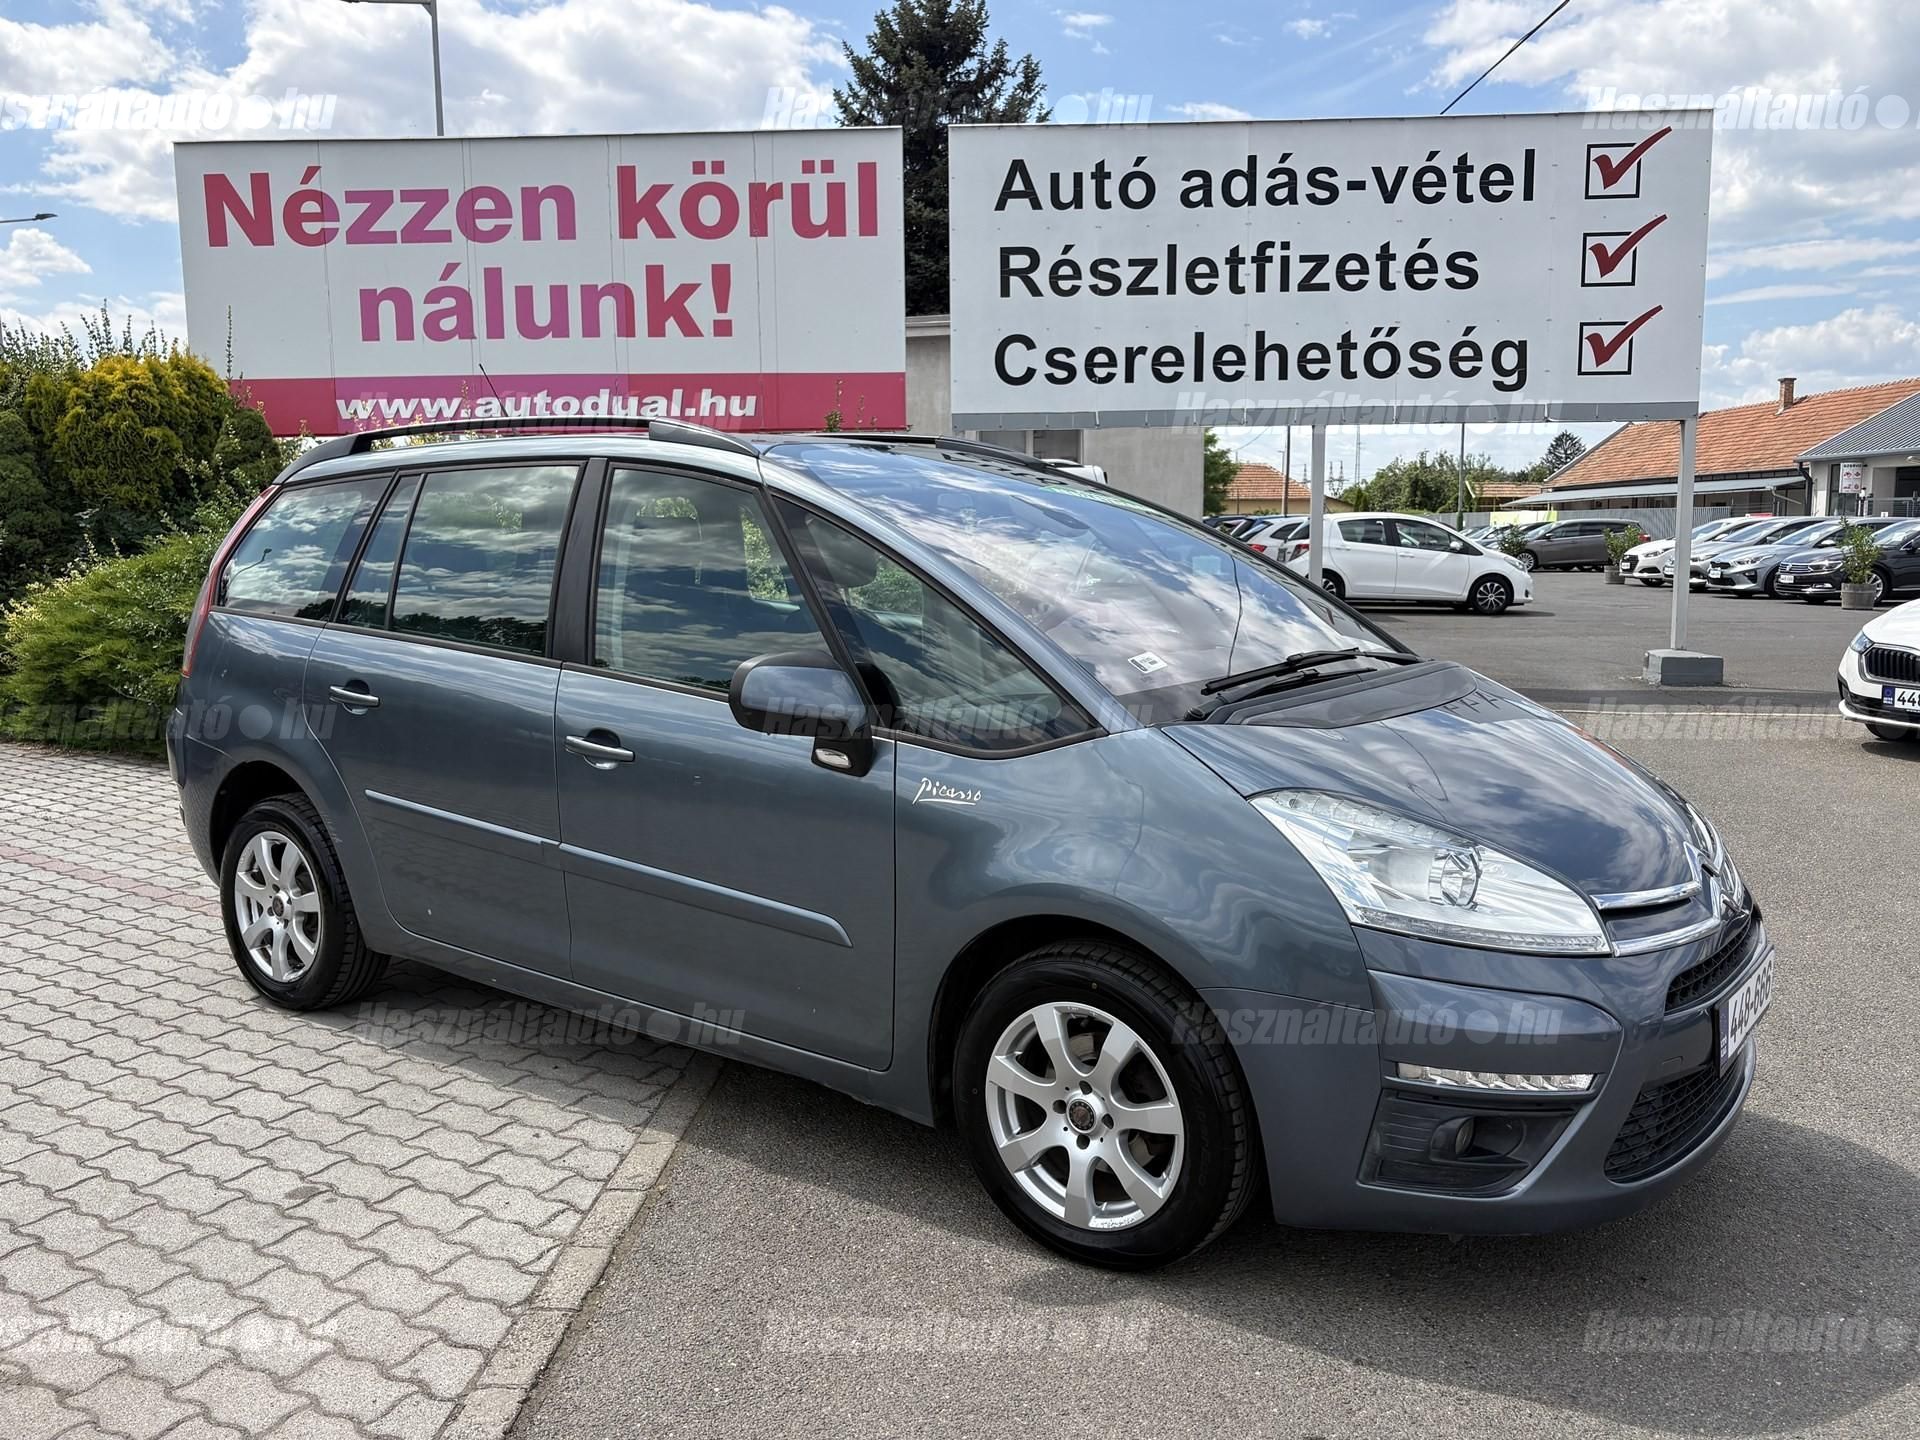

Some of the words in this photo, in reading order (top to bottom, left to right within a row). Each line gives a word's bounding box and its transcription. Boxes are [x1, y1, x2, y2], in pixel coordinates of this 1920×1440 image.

[204, 165, 577, 248] Nézzen
[617, 160, 879, 240] körül
[994, 156, 1156, 211] Autó
[1180, 148, 1536, 209] adás-vétel
[1000, 237, 1479, 298] Részletfizetés
[360, 262, 733, 342] nálunk!
[994, 325, 1528, 392] Cserelehetőség
[336, 388, 757, 421] www.autodual.hu
[912, 777, 982, 805] Picasso
[1730, 959, 1772, 1044] 448-666
